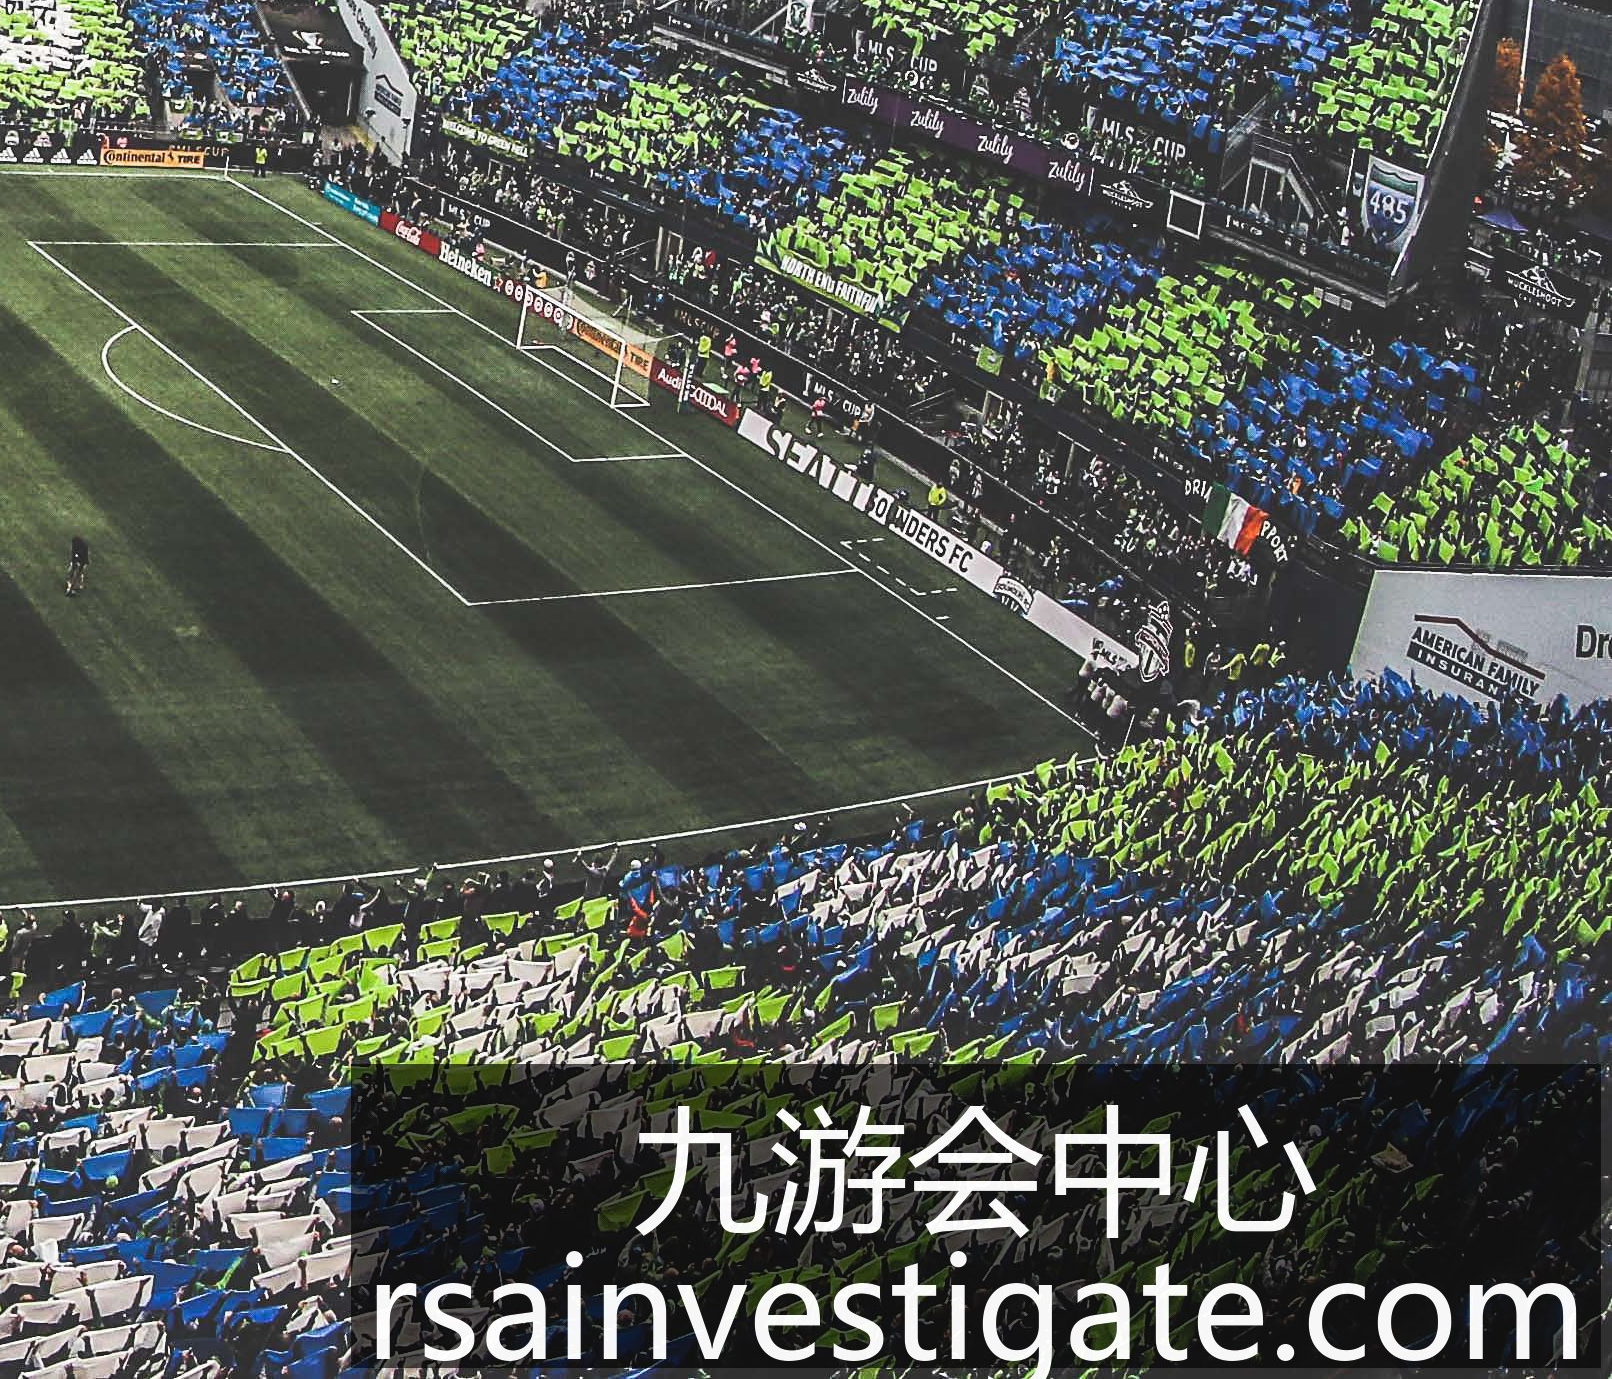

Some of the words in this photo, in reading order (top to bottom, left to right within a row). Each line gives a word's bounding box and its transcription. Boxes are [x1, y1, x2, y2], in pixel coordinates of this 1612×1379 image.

[442, 118, 475, 140] WELCOME
[477, 130, 487, 144] TO
[104, 150, 165, 165] Continental
[177, 155, 202, 165] TIRE
[1369, 190, 1409, 224] 485
[439, 241, 492, 287] Heineken
[780, 254, 815, 284] NORTH
[815, 271, 836, 293] END
[630, 352, 650, 371] TIRE
[658, 368, 684, 390] Audi
[950, 545, 974, 573] FC
[1411, 626, 1486, 672] AMERICAN
[1488, 661, 1540, 697] FAMILY
[1417, 649, 1499, 696] INSURAN
